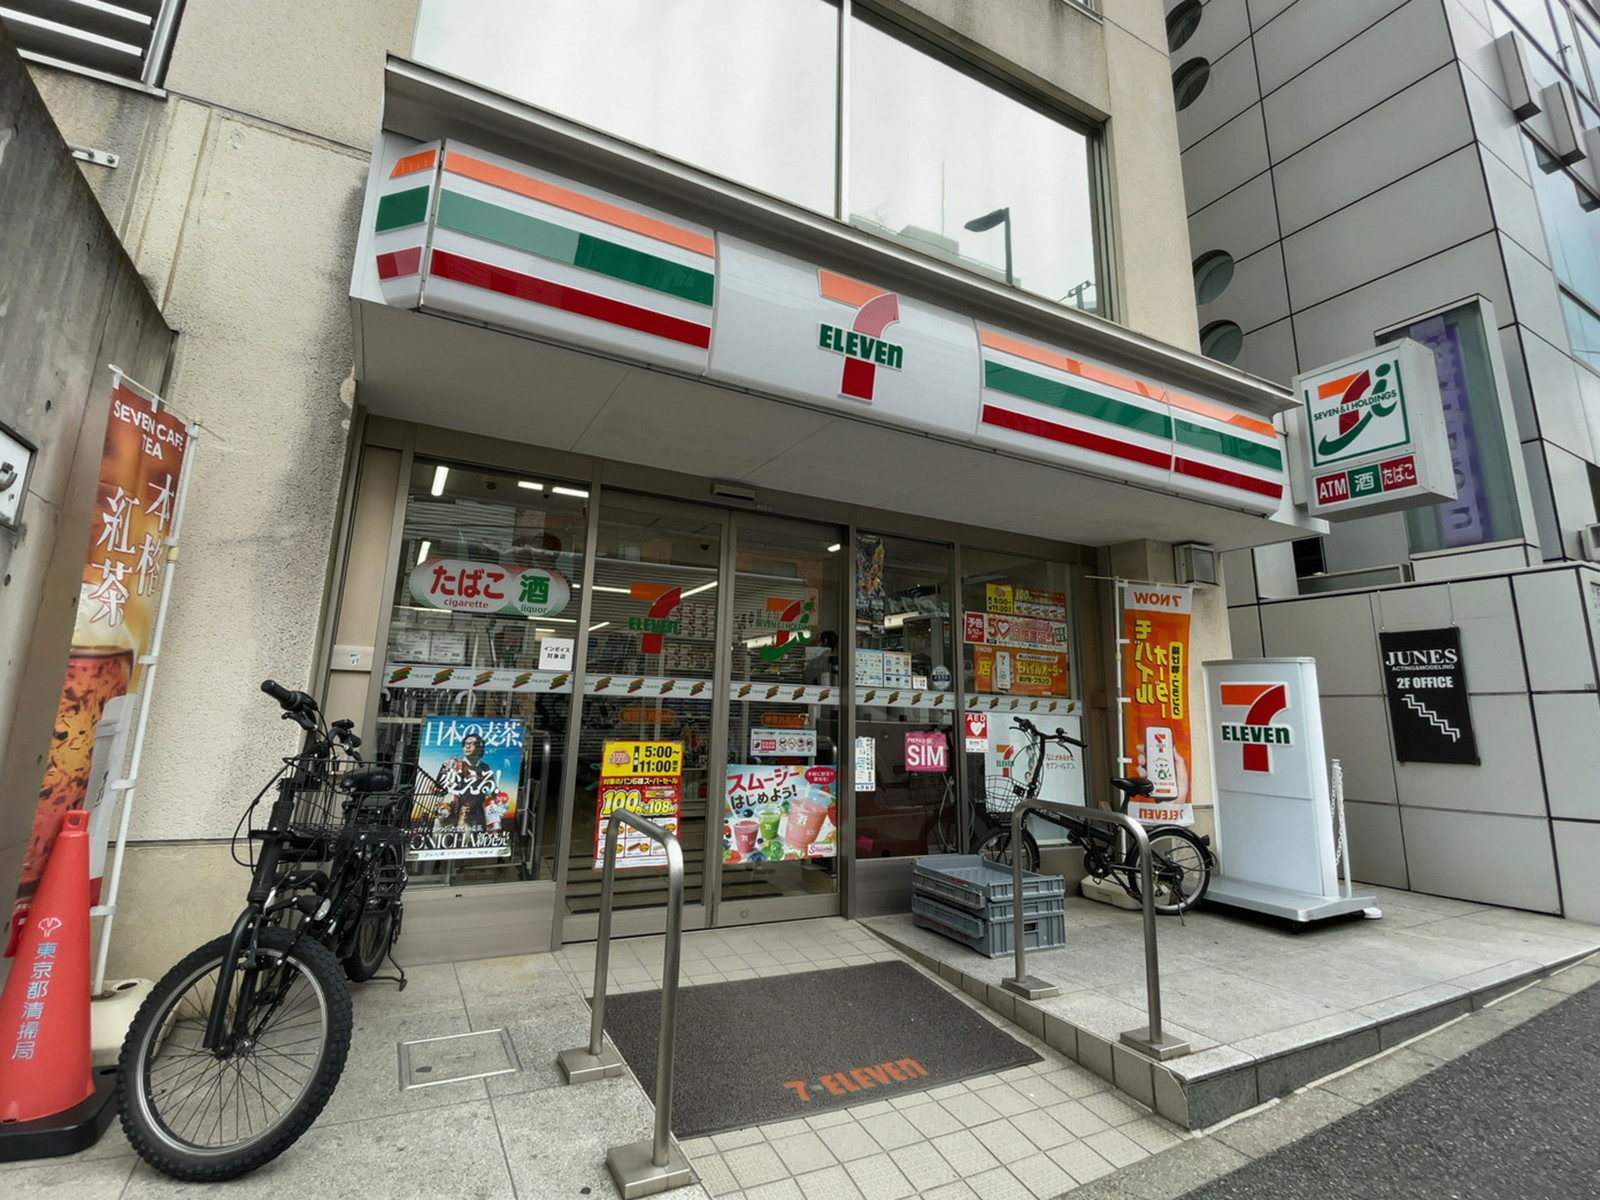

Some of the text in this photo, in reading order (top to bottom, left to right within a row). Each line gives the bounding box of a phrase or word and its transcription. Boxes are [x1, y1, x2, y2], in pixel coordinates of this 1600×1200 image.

[1351, 389, 1397, 410] HOLDINGS
[113, 400, 157, 436] SEVEN
[142, 434, 163, 461] TEA
[1353, 471, 1375, 492] 酒
[1382, 463, 1416, 485] たばこ
[1319, 479, 1346, 499] ATM
[136, 474, 175, 597] 本格
[89, 487, 140, 627] 紅茶
[430, 565, 551, 604] たばこ 酒
[443, 597, 489, 610] cigarette
[520, 603, 548, 614] liquor
[1385, 648, 1458, 667] JUNES
[1396, 676, 1454, 689] 2F OFFICE
[966, 714, 986, 723] AED
[639, 760, 671, 773] 11:00
[907, 745, 945, 767] SIM
[726, 766, 800, 795] スムージー
[731, 784, 799, 810] はじめよう!
[11, 941, 60, 1061] 東京都清掃局
